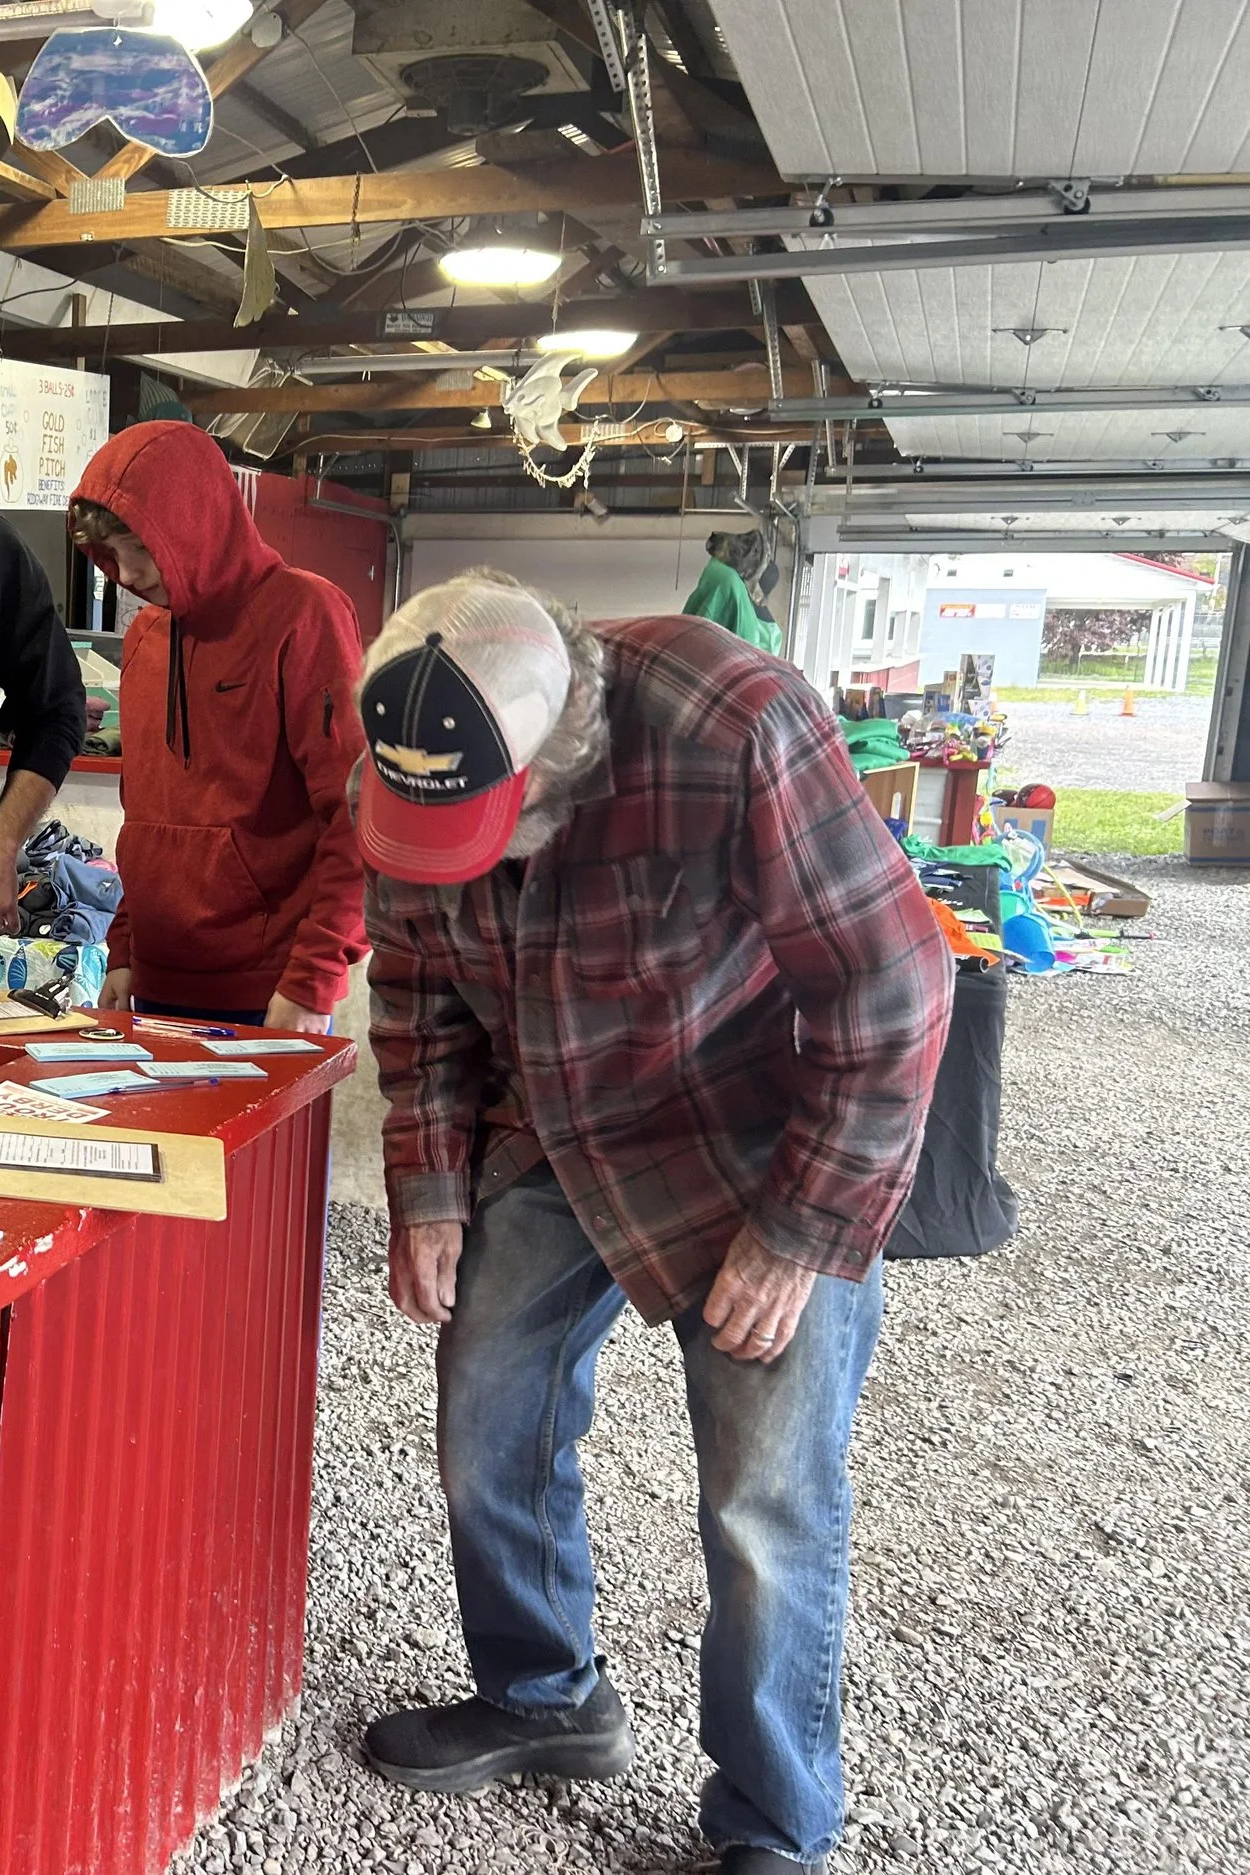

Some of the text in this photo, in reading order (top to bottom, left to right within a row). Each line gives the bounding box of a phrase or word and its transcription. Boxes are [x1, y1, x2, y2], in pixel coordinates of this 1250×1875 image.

[38, 379, 44, 394] 3
[42, 411, 65, 433] GOLD
[41, 433, 65, 454] FISH
[38, 456, 66, 477] PITCH
